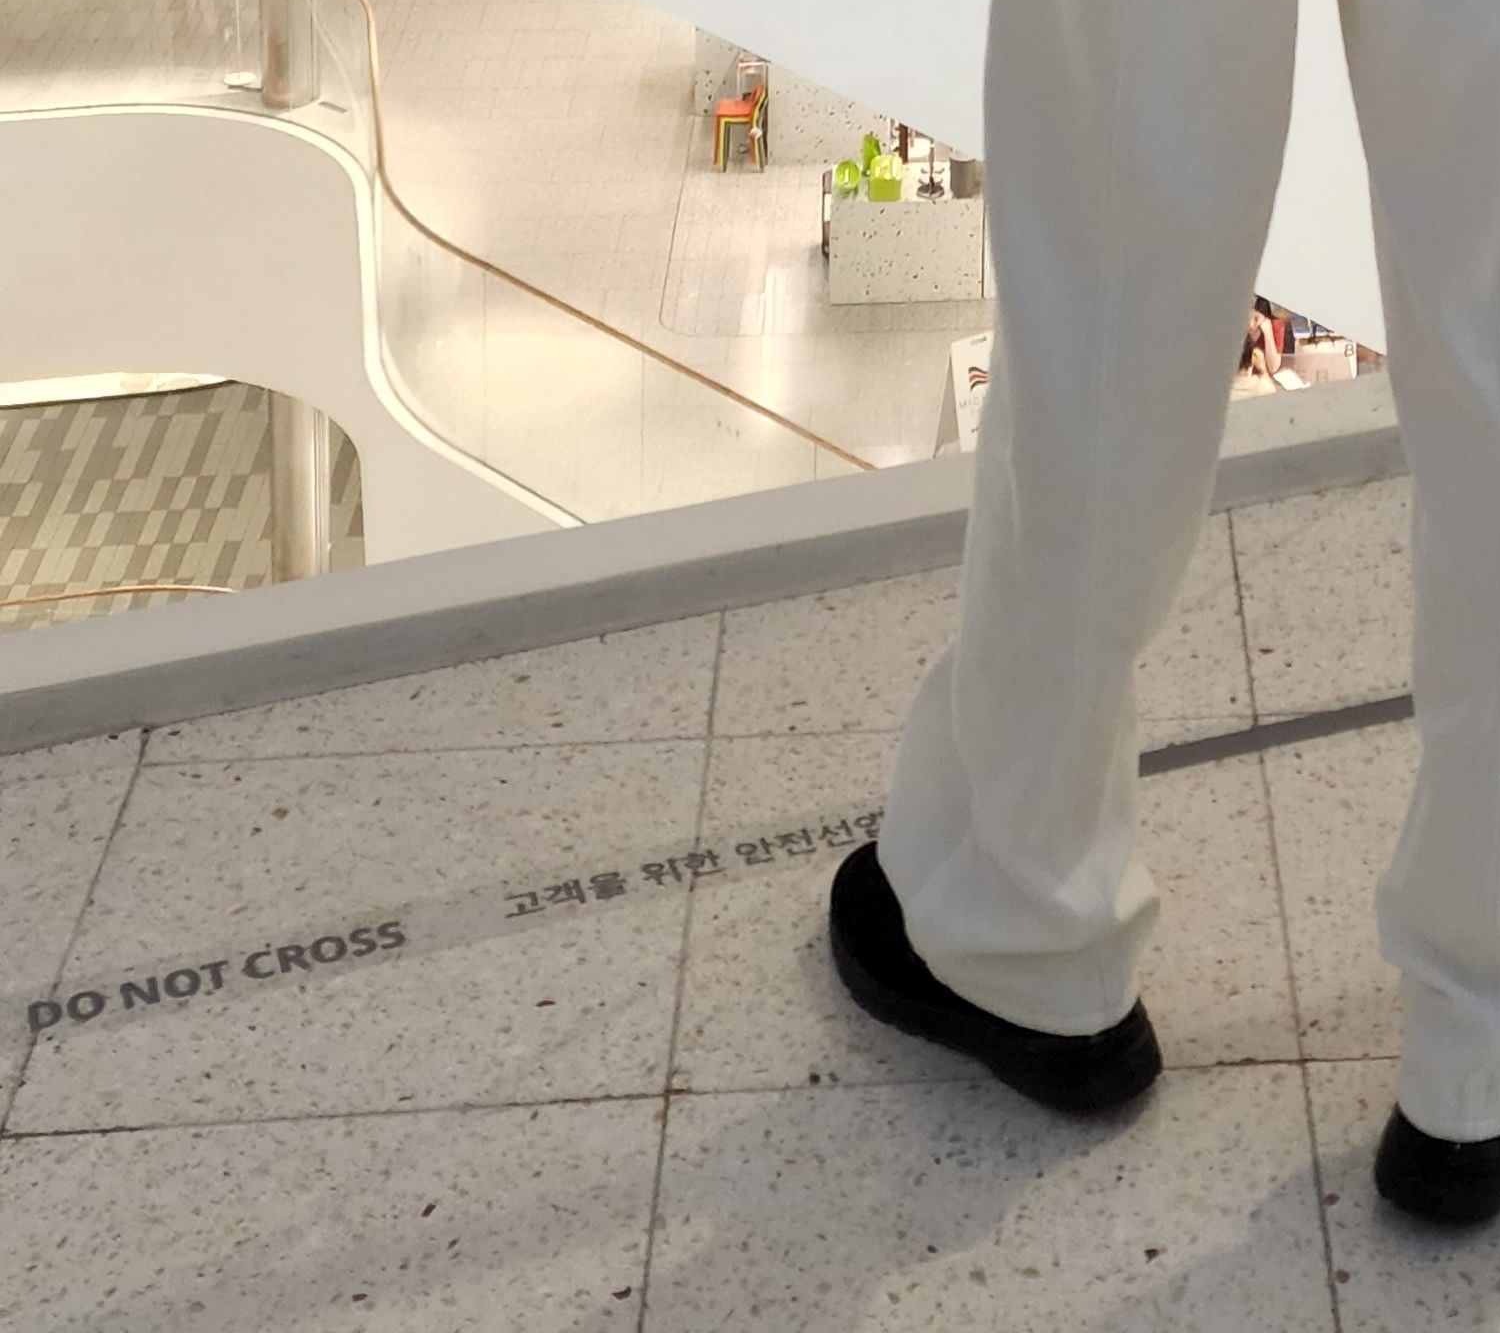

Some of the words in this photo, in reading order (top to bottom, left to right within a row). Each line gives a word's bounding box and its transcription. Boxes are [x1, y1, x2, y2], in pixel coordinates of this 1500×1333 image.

[505, 871, 627, 919] 고객을
[641, 848, 722, 886] 위한
[27, 989, 107, 1033] DO
[119, 959, 229, 1010] NOT
[241, 920, 407, 980] CROSS
